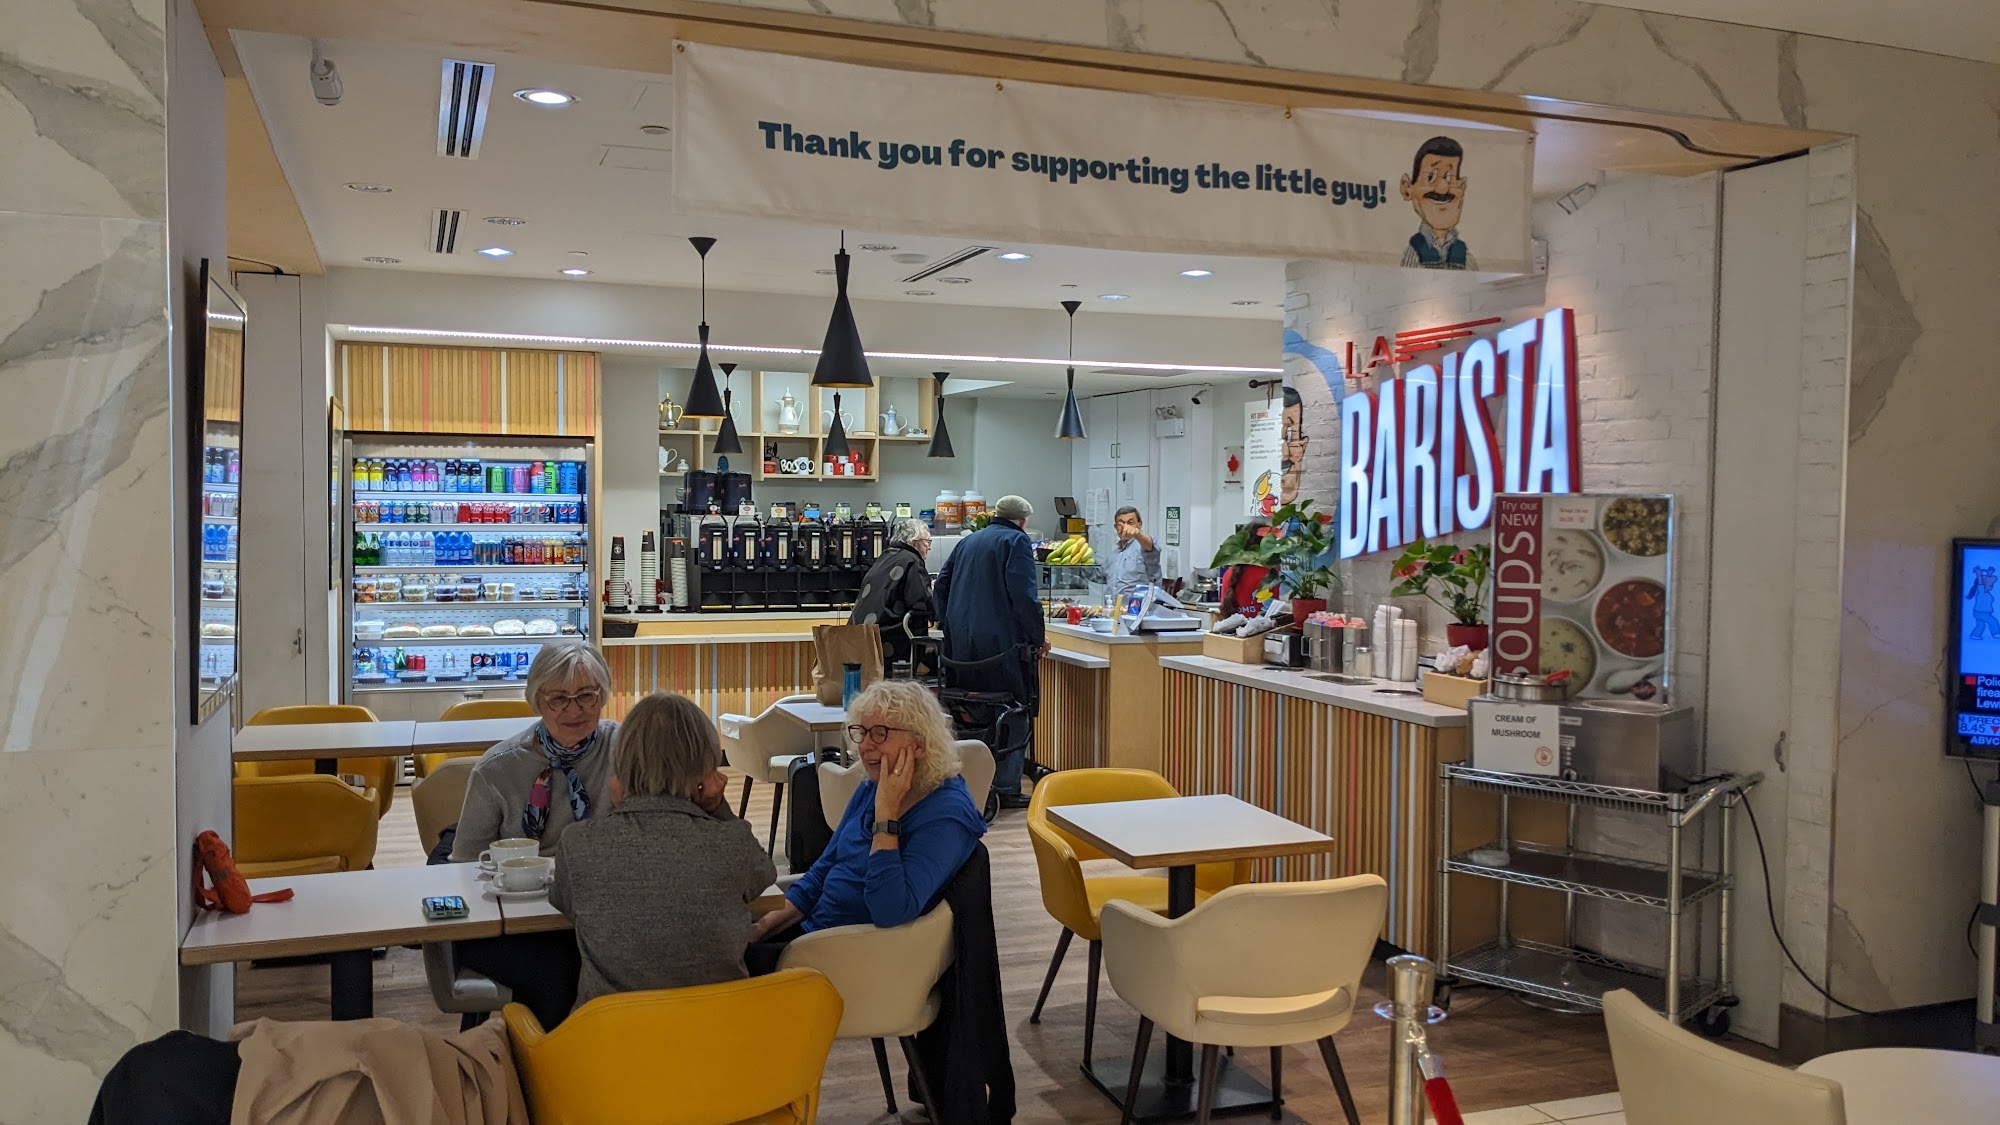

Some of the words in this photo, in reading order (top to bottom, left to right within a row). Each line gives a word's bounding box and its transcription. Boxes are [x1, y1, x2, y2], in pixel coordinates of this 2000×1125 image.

[758, 120, 872, 161] Thank
[877, 141, 942, 170] you
[947, 138, 1006, 169] for
[1011, 150, 1189, 194] supporting
[1194, 162, 1250, 190] the
[1255, 163, 1328, 197] little
[1331, 180, 1387, 210] guy!
[1346, 336, 1395, 379] LA
[1340, 307, 1579, 560] BARISTA
[545, 471, 553, 490] PRIME
[1501, 500, 1518, 512] Try
[1520, 501, 1538, 511] our
[1167, 510, 1179, 519] PASS
[1501, 513, 1539, 527] NEW
[1495, 714, 1524, 724] CREAM
[1526, 716, 1537, 724] OF
[1491, 728, 1541, 739] MUSHROOM
